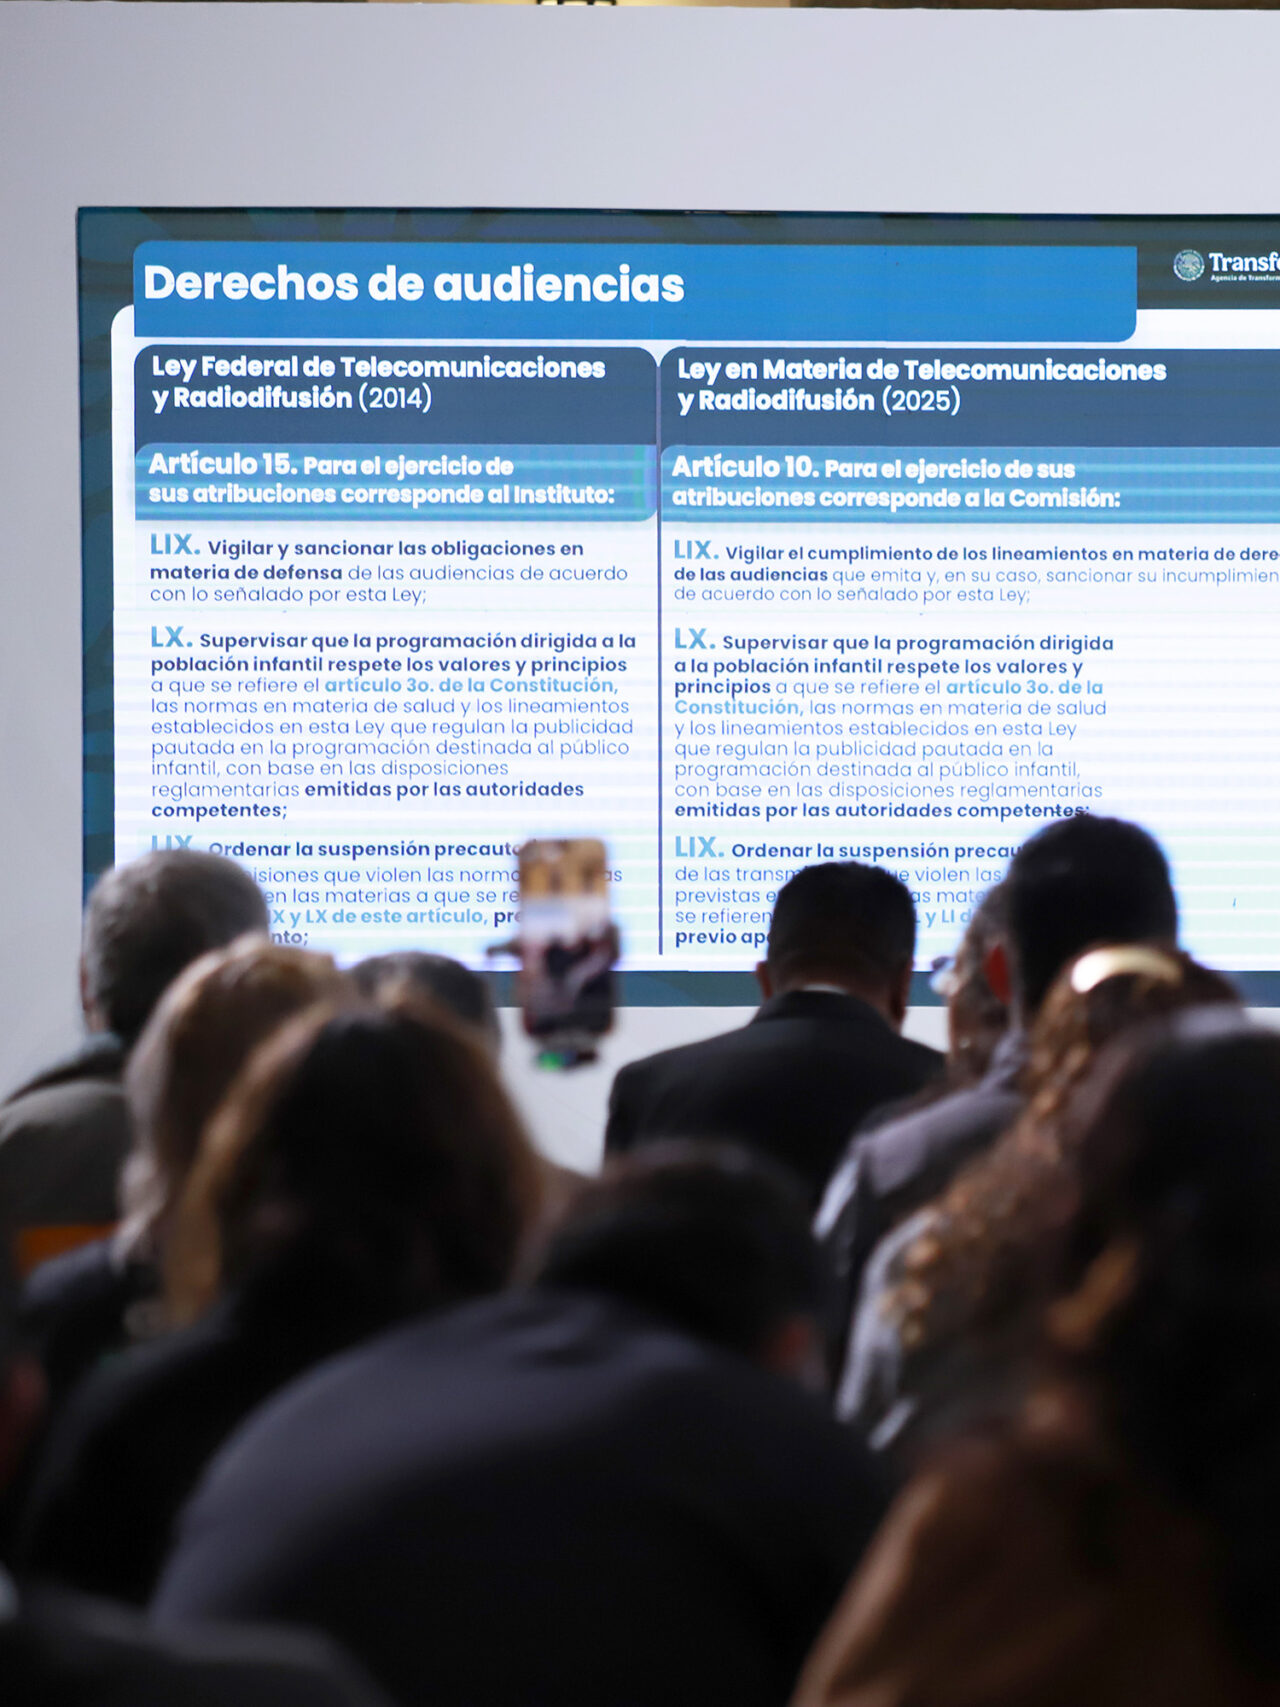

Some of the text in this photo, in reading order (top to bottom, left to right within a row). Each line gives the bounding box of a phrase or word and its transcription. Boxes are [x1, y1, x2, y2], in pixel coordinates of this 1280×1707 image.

[144, 264, 685, 302] Derechos de audiencias
[1210, 274, 1237, 283] Agencia
[152, 355, 606, 382] Ley Federal de Telecomunicaciones
[678, 357, 1167, 385] Ley en Materia de Telecomunicaciones
[151, 383, 432, 413] y Radiodifusión (2014)
[677, 385, 961, 416] y Radiodifusión (2025)
[148, 450, 514, 480] Artículo 15. Para el ejercicio de
[671, 453, 1075, 484] Artículo 10. Para el ejercicio de sus
[150, 483, 615, 509] sus atribuciones corresponde al Instituto:
[672, 486, 1121, 512] atribuciones corresponde a la Comisión:
[150, 533, 585, 561] LIX. Vigilar y sancionar las obligaciones en
[673, 539, 720, 560] LIX.
[725, 545, 786, 565] Vigilar
[787, 546, 804, 560] el
[807, 545, 934, 565] cumplimiento
[935, 546, 960, 560] de
[962, 546, 988, 560] los
[991, 545, 1109, 560] lineamientos
[1111, 550, 1135, 561] en
[1137, 546, 1210, 561] materia
[1213, 547, 1237, 561] de
[149, 563, 629, 581] materia de defensa de las audiencias de acuerdo
[673, 566, 697, 581] de
[699, 567, 726, 581] las
[729, 566, 829, 582] audiencias
[832, 571, 866, 586] que
[870, 568, 922, 582] emita
[926, 571, 940, 586] y,
[944, 571, 967, 582] en
[970, 571, 991, 582] su
[995, 571, 1042, 584] caso,
[1046, 568, 1134, 583] sancionar
[1137, 571, 1158, 582] su
[149, 586, 427, 606] con lo señalado por esta Ley;
[673, 586, 1031, 605] de acuerdo con lo señalado por esta Ley;
[150, 626, 637, 653] LX. Supervisar que la programación dirigida a la
[674, 627, 1115, 655] LX. Supervisar que la programación dirigida
[674, 761, 1081, 783] programación destinada al público infantil,
[151, 780, 585, 802] reglamentarias emitidas por las autoridades
[151, 804, 288, 823] competentes;
[674, 801, 762, 817] emitidas
[765, 806, 799, 823] por
[802, 802, 831, 817] las
[834, 801, 953, 818] autoridades
[205, 840, 431, 861] Ordenar la suspensión
[674, 836, 950, 863] LIX. Ordenar la suspensión
[305, 907, 489, 925] LX de este artículo,
[675, 929, 738, 948] previo
